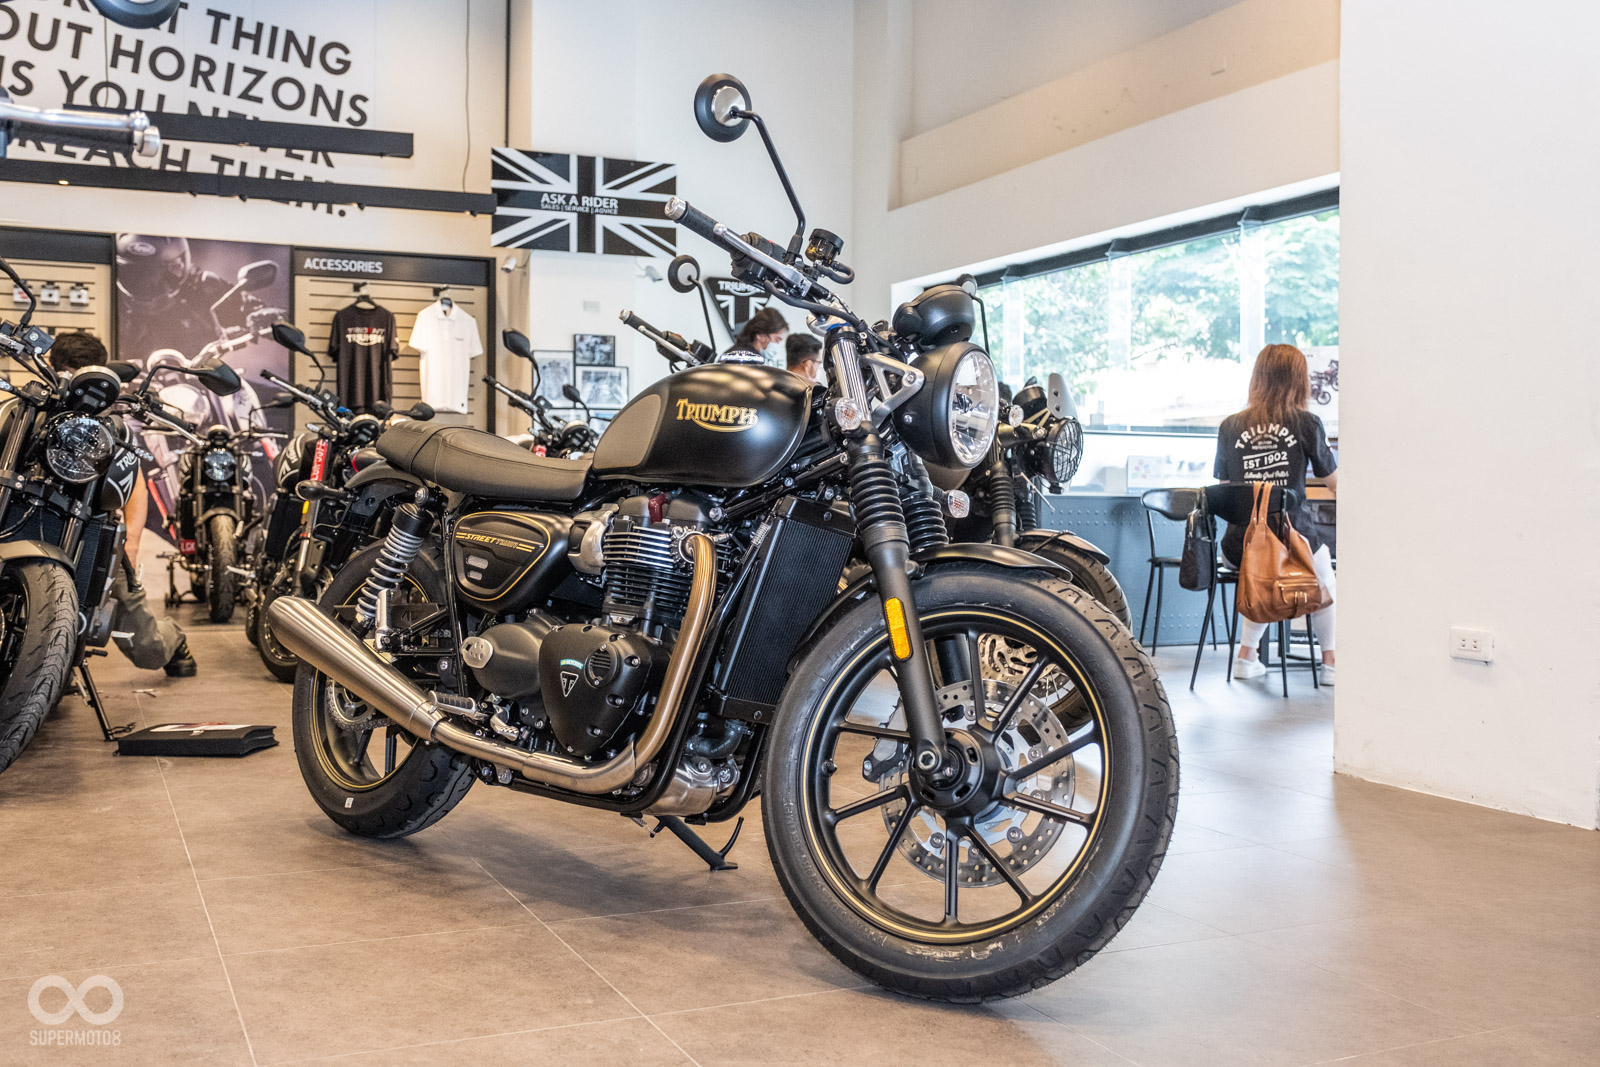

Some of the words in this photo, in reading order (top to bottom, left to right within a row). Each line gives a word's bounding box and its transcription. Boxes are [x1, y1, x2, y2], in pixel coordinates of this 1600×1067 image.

[206, 8, 352, 76] THING
[110, 33, 369, 127] HORIZONS
[541, 192, 567, 205] ASK
[569, 195, 579, 206] A
[582, 196, 619, 209] RIDER
[304, 257, 383, 274] ACCESSORIES
[717, 280, 766, 296] TRIUM
[676, 398, 759, 431] TRIUMPH
[1234, 423, 1298, 449] TRIUMPH
[1243, 459, 1261, 470] EST
[1264, 451, 1288, 465] 1902
[465, 533, 497, 544] STREET
